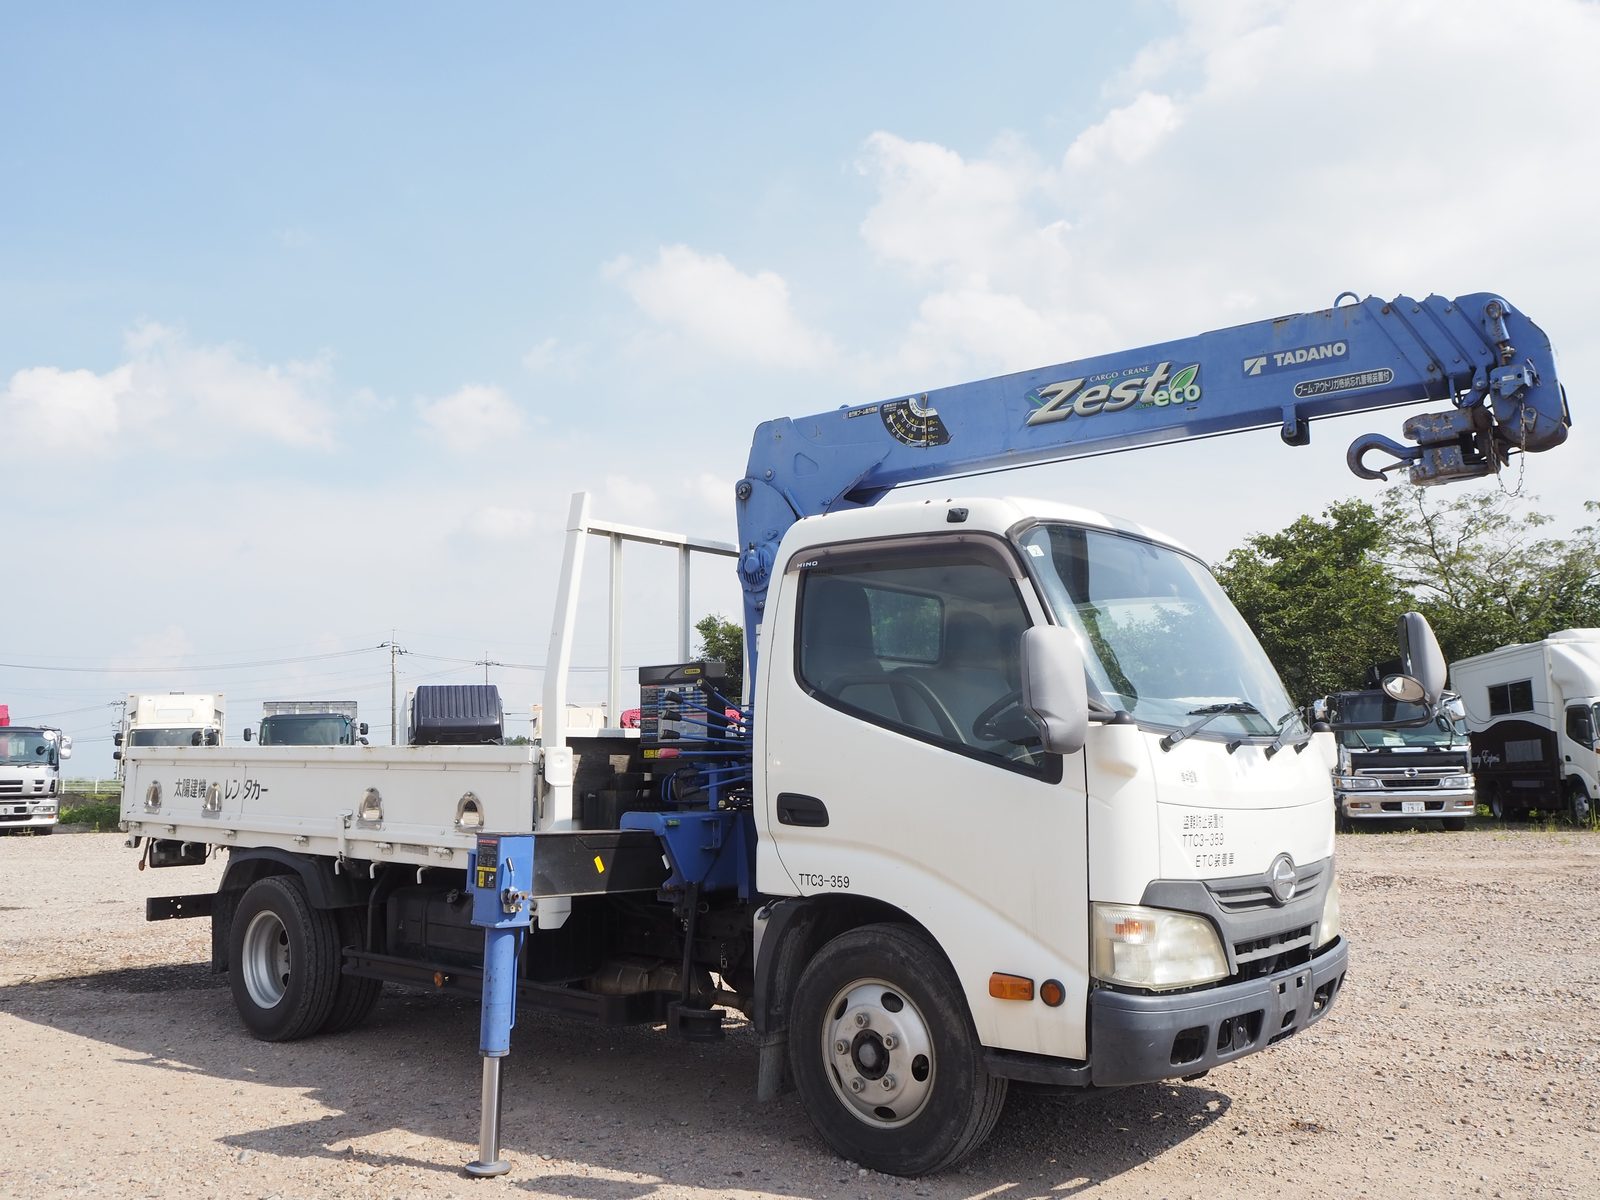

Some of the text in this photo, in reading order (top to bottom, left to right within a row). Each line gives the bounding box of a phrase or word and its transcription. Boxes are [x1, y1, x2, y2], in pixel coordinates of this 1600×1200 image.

[1273, 341, 1347, 368] TADANO
[1089, 365, 1151, 383] CARGO CRANE
[1026, 361, 1202, 426] Zest eco
[796, 561, 818, 569] HINO
[173, 778, 269, 800] 太陽建機 レンタカー
[1182, 832, 1225, 848] TTC3-359
[799, 873, 850, 889] TTC3-359
